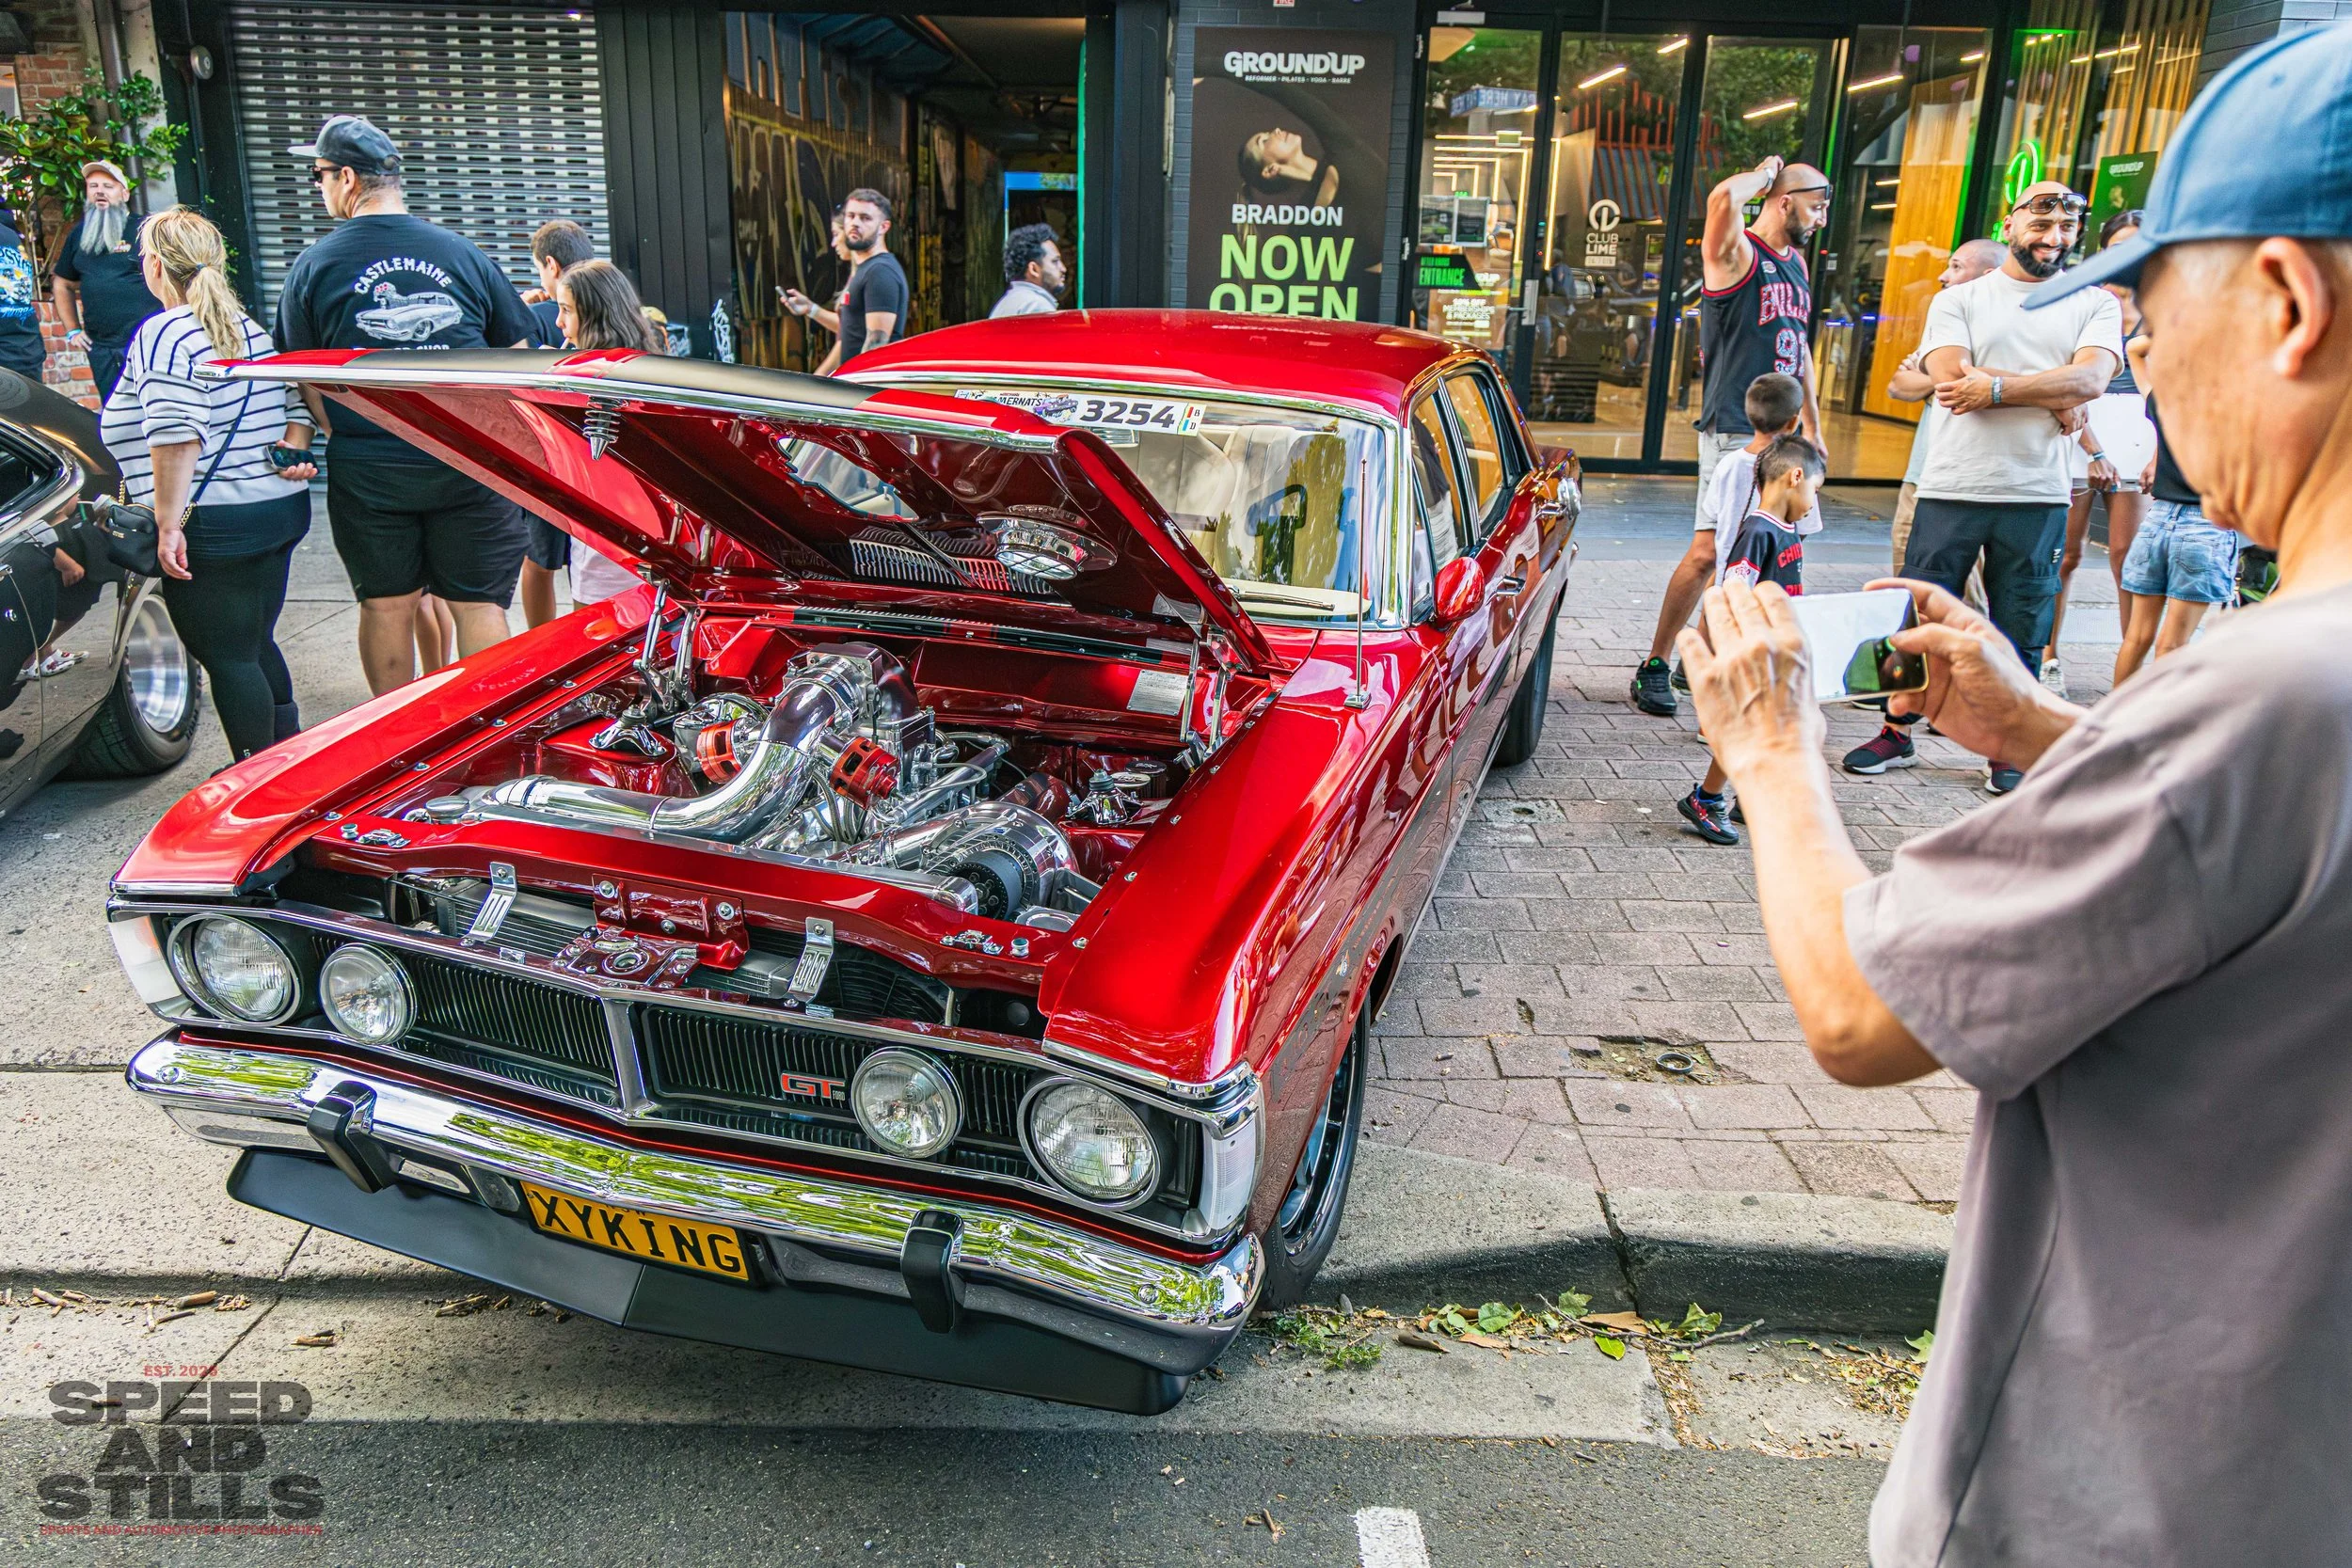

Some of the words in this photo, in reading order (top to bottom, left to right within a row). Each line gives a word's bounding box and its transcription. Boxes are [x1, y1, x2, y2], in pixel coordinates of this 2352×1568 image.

[1224, 51, 1365, 77] GROUNDUP
[1232, 203, 1343, 227] BRADDON
[1585, 244, 1617, 255] LIME
[1586, 232, 1619, 245] CLUB
[1220, 234, 1355, 282] NOW
[354, 257, 453, 295] CASTLEMAINE
[1419, 267, 1466, 288] ENTRANCE
[1209, 282, 1359, 321] OPEN
[1079, 399, 1174, 429] 3254
[781, 1073, 846, 1100] GT
[833, 1090, 846, 1101] FORD
[532, 1191, 740, 1273] XYKING
